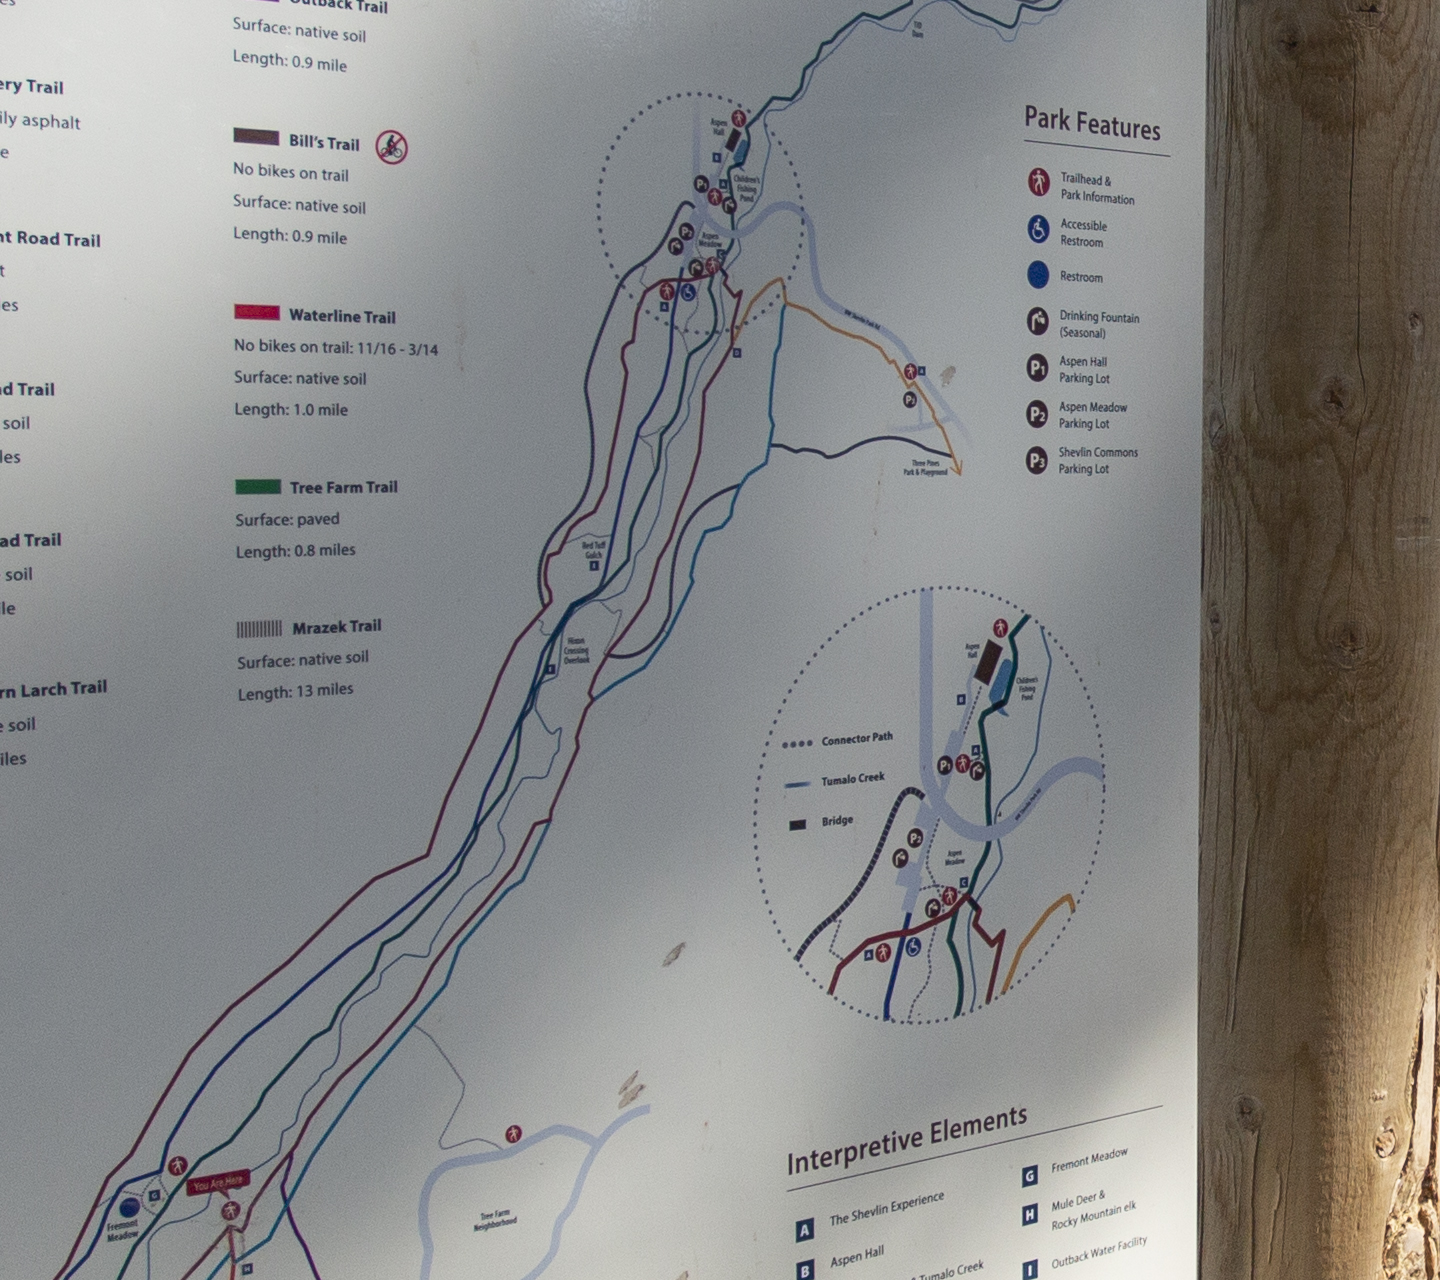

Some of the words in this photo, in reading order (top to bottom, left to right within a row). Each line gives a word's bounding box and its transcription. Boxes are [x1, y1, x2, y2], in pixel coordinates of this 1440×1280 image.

[357, 0, 387, 13] Trail
[27, 79, 63, 94] Trail
[23, 115, 80, 130] asphalt
[1026, 105, 1069, 130] Park
[1078, 111, 1160, 140] Features
[290, 134, 324, 148] Bill's
[328, 137, 359, 151] Trail
[1062, 172, 1102, 185] Trailhead
[1105, 177, 1111, 186] &
[1062, 189, 1080, 199] Park
[1083, 191, 1135, 204] Information
[1061, 219, 1107, 231] Accessible
[18, 231, 59, 245] Road
[65, 233, 100, 247] Trail
[1061, 235, 1103, 247] Restroom
[1061, 271, 1103, 282] Restroom
[290, 309, 361, 322] Waterline
[365, 311, 395, 323] Trail
[1060, 310, 1098, 324] Drinking
[1102, 312, 1139, 323] Fountain
[1060, 327, 1105, 339] (Seasonal)
[235, 339, 254, 351] No
[260, 339, 295, 352] bikes
[300, 344, 318, 352] on
[323, 341, 354, 353] trail:
[359, 343, 396, 355] 11/16
[410, 344, 438, 355] 3/14
[235, 371, 292, 384] Surface:
[297, 374, 339, 384] native
[344, 373, 366, 385] soil
[18, 383, 54, 395] Trail
[235, 403, 289, 418] Length:
[295, 404, 314, 416] 1.0
[319, 404, 348, 416] mile
[3, 417, 29, 429] soil
[291, 482, 322, 494] Tree
[327, 482, 362, 493] Farm
[367, 481, 397, 492] Trail
[25, 533, 61, 546] Trail
[6, 567, 32, 581] soil
[294, 621, 346, 634] Mrazek
[350, 619, 381, 632] Trail
[22, 682, 67, 697] Larch
[71, 680, 107, 694] Trail
[9, 717, 35, 732] soil
[822, 735, 870, 746] Connector
[873, 732, 893, 741] Path
[822, 775, 856, 785] Tumalo
[859, 772, 884, 782] Creek
[789, 1131, 923, 1175] Interpretive
[931, 1108, 1027, 1143] Elements
[225, 1176, 243, 1186] Here
[831, 1215, 849, 1225] The
[852, 1205, 888, 1221] Shevlin
[891, 1193, 944, 1212] Experience
[831, 1254, 862, 1267] Aspen
[865, 1245, 884, 1258] Hall
